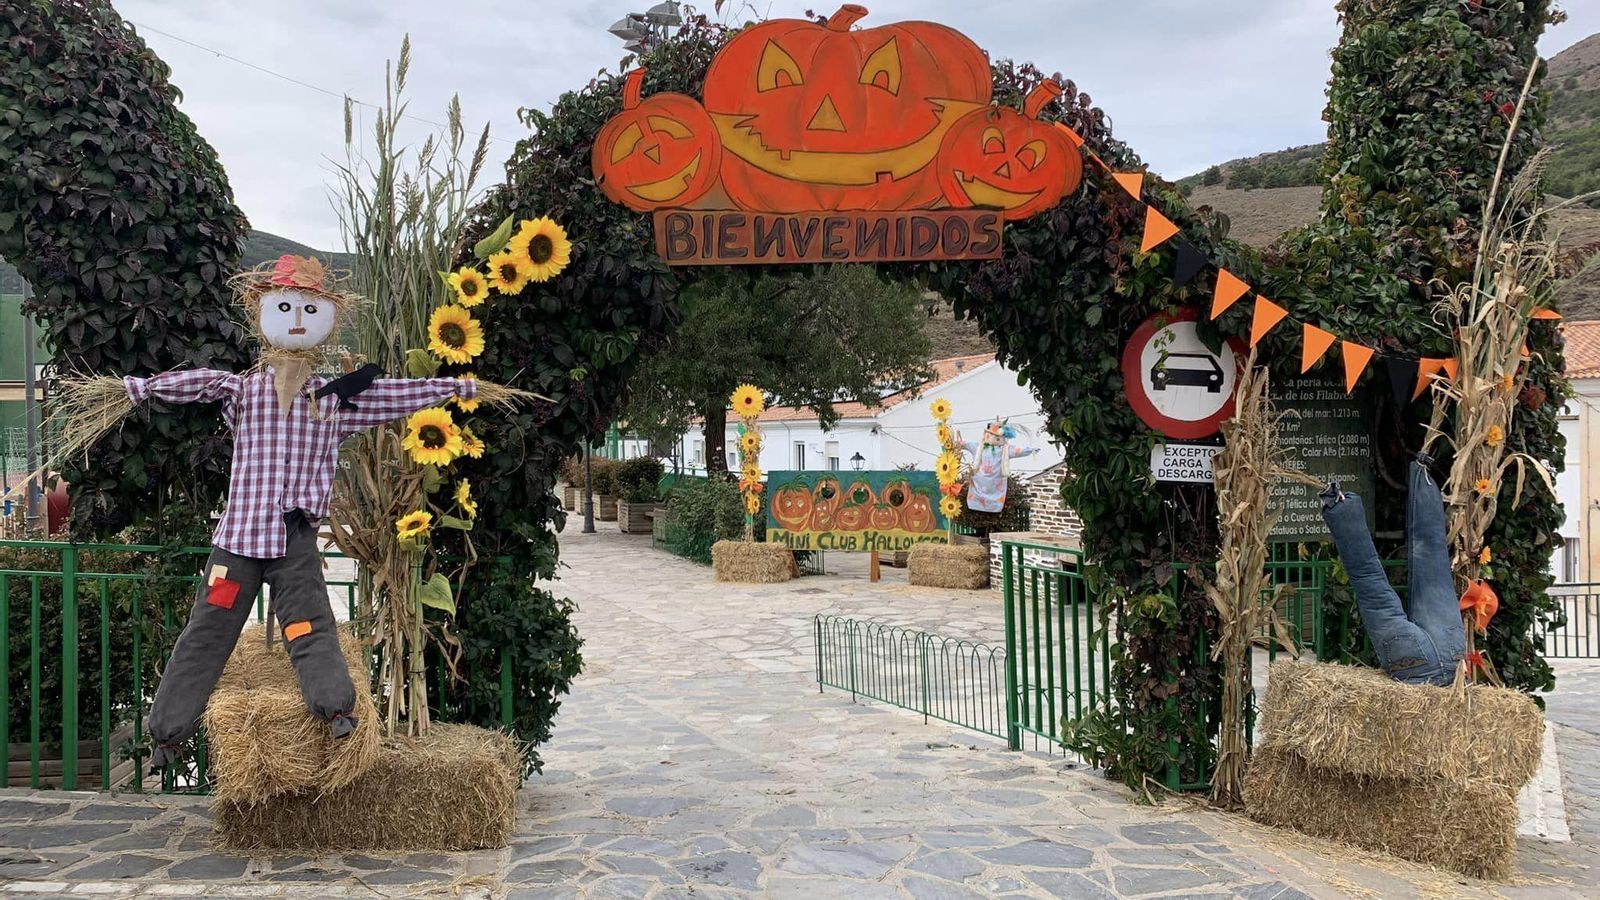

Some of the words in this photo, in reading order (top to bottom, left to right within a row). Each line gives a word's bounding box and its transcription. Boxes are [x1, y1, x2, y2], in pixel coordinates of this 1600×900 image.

[665, 213, 1003, 259] BIENVENIDOS
[1285, 390, 1298, 401] de
[1300, 390, 1314, 401] los
[1302, 408, 1314, 418] del
[1164, 447, 1216, 458] EXCEPTO
[1302, 447, 1321, 457] Calar
[1163, 458, 1203, 469] CARGA
[1158, 469, 1215, 480] DESCARG
[1309, 499, 1319, 509] de
[1290, 513, 1314, 522] Cueva
[816, 532, 857, 550] CLUB
